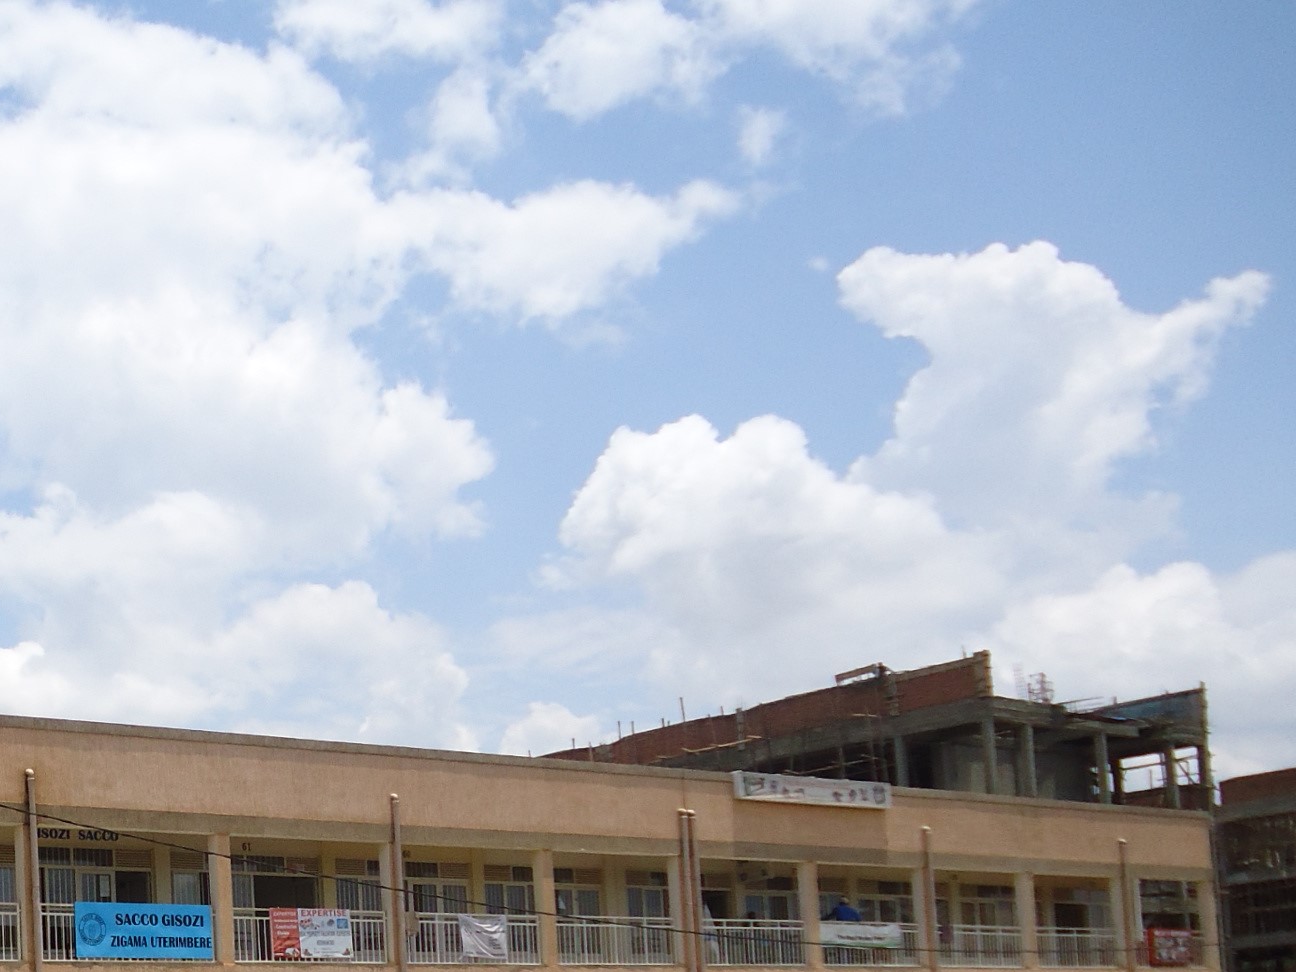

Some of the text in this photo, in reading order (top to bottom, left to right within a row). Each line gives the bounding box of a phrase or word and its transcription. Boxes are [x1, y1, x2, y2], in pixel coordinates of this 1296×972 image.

[37, 828, 119, 841] ISOZI SACCO
[301, 909, 347, 917] EXPERTISE
[115, 913, 204, 927] SACCO GISOZI
[110, 935, 212, 948] ZIGAMA UTERIMBERE
